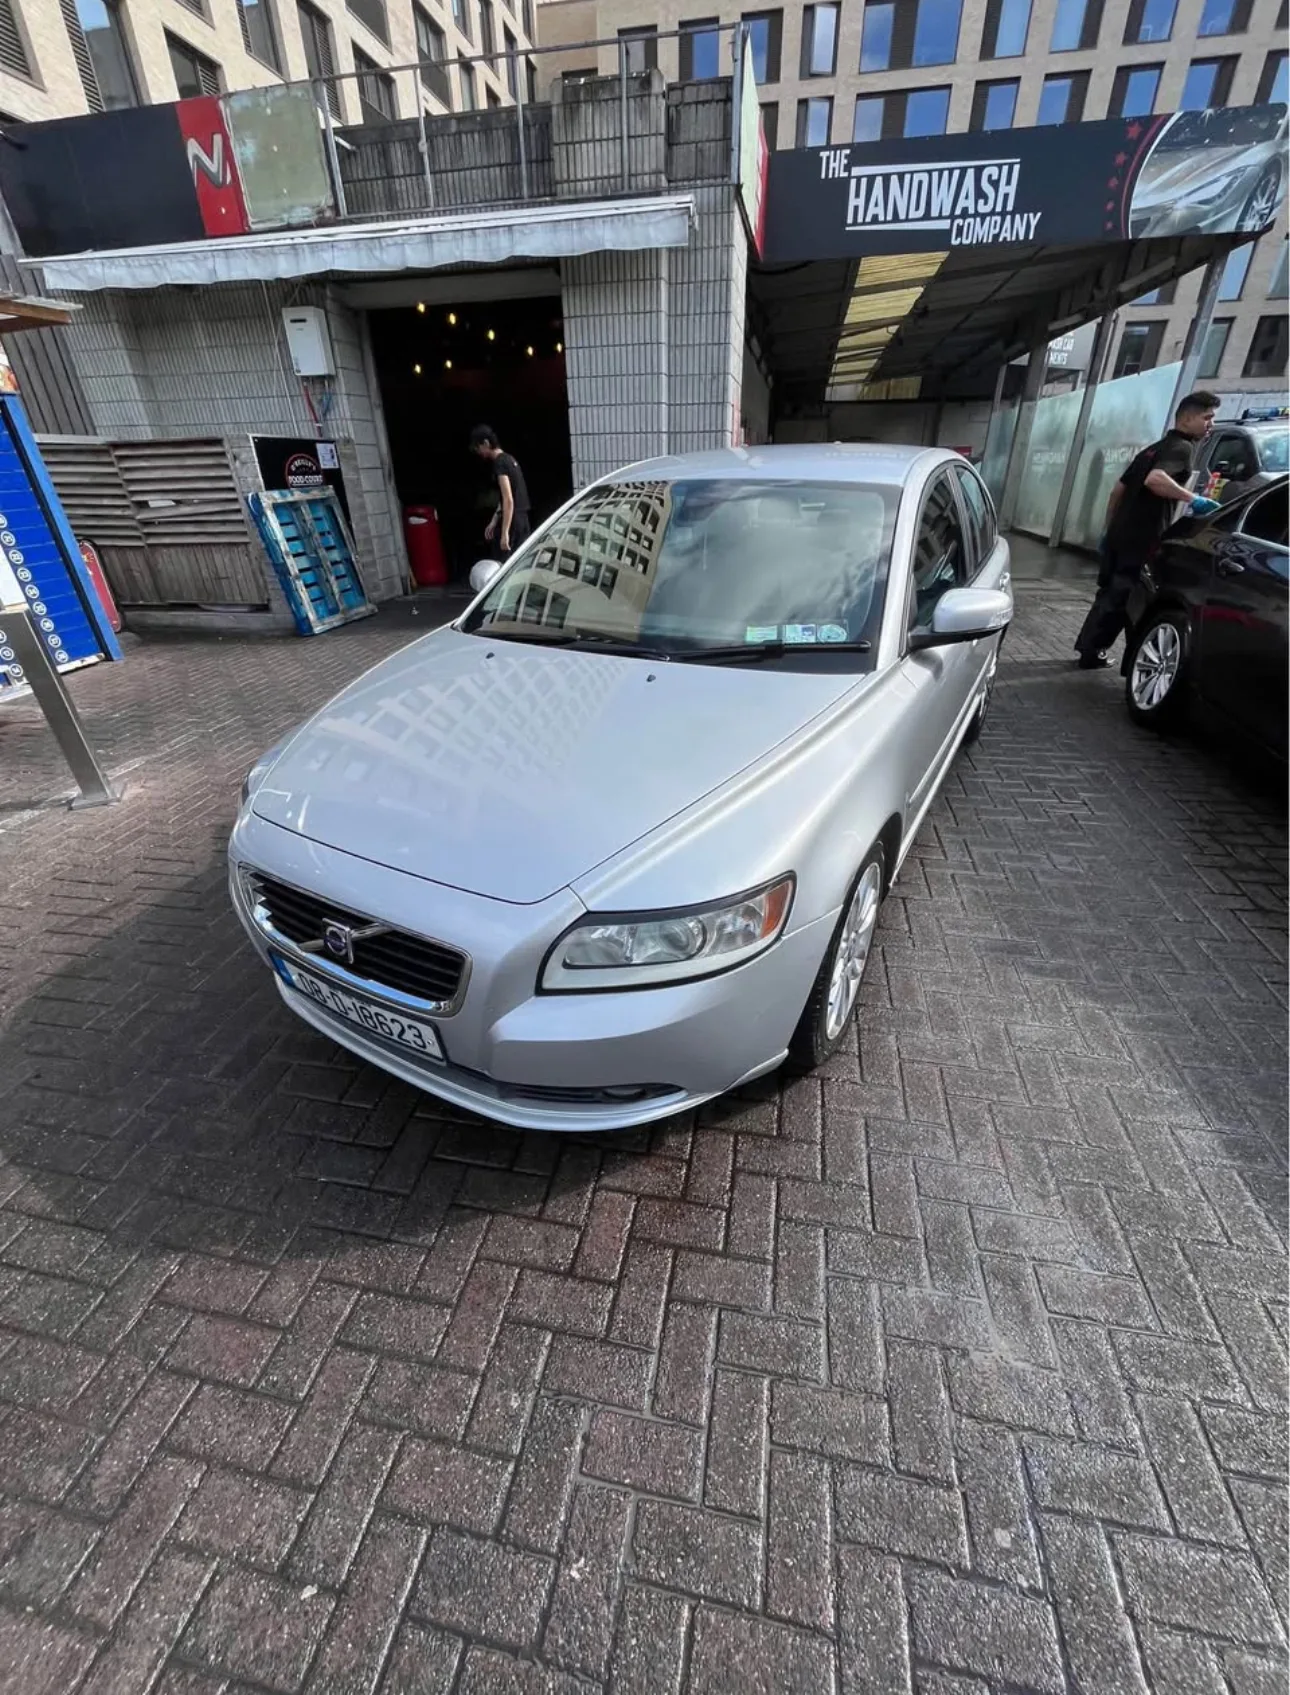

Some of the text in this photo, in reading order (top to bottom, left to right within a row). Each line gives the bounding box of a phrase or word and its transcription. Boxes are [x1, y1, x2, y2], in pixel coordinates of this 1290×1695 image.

[819, 149, 851, 179] THE
[847, 163, 1021, 224] HANDWASH
[950, 211, 1042, 245] COMPANY
[298, 973, 428, 1050] 08-D-18623
